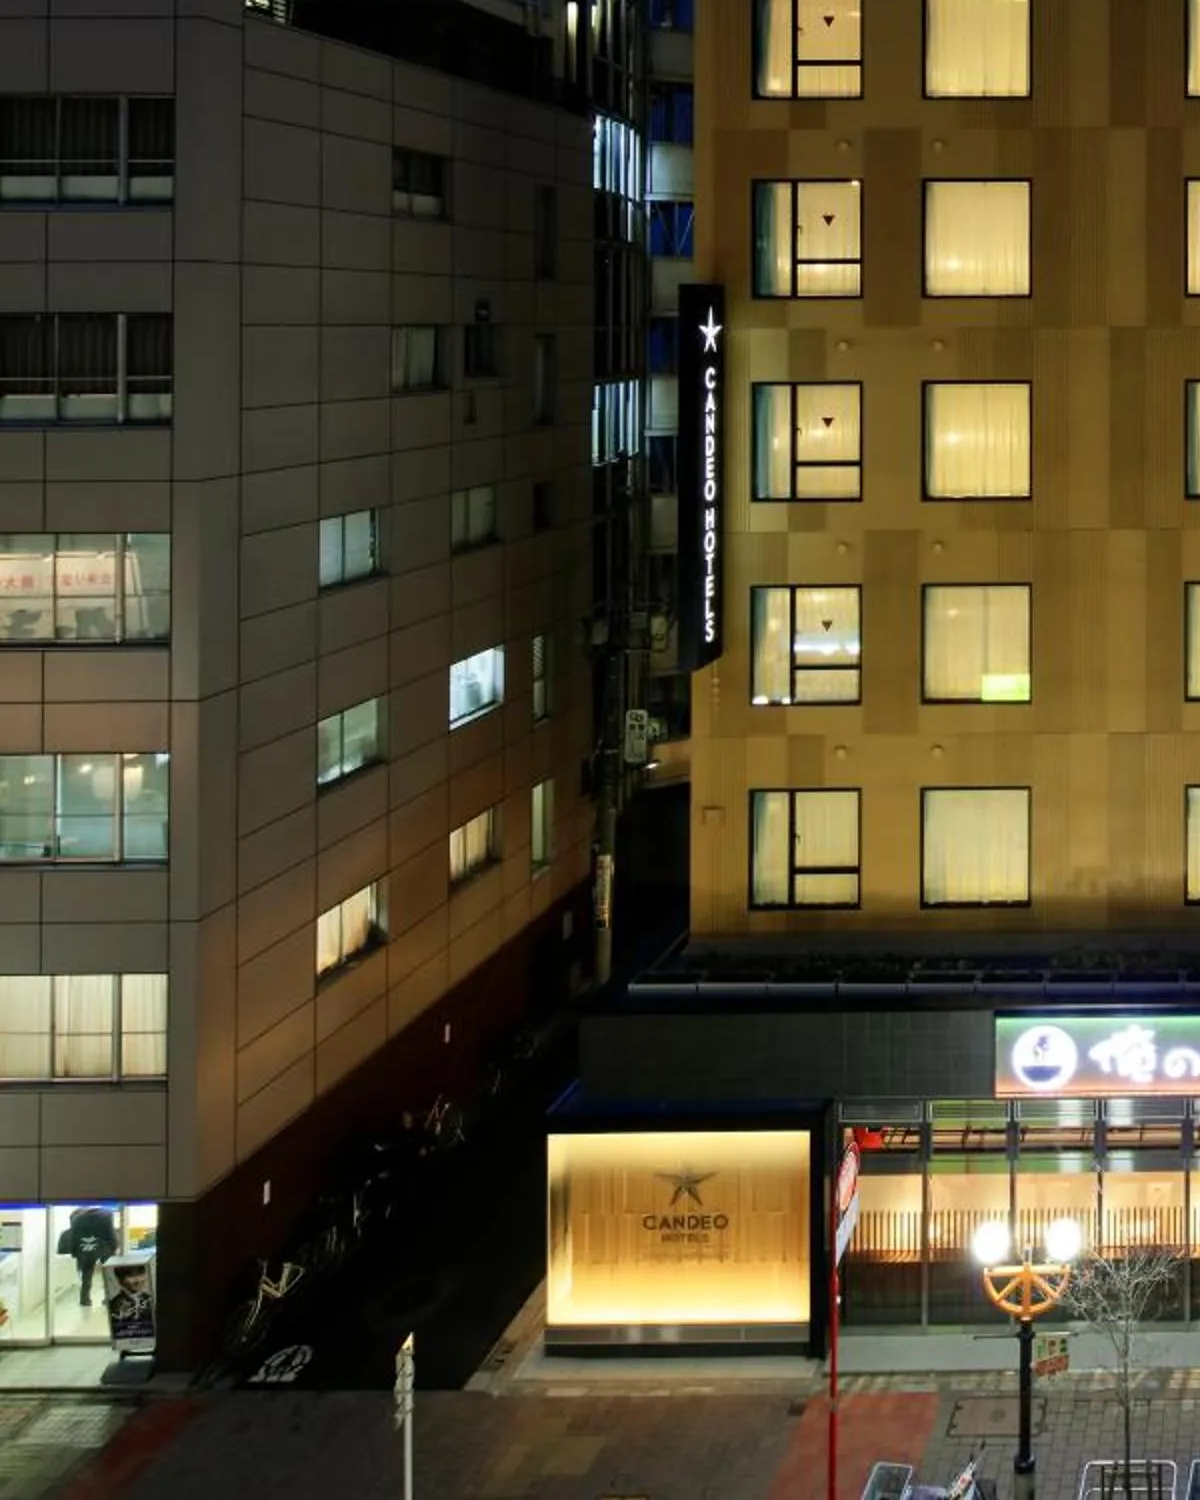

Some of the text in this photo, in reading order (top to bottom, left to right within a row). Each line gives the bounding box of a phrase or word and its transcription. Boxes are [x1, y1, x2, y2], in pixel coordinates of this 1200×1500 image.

[703, 366, 717, 643] CANDEO HOTELS
[642, 1214, 729, 1230] CANDEO
